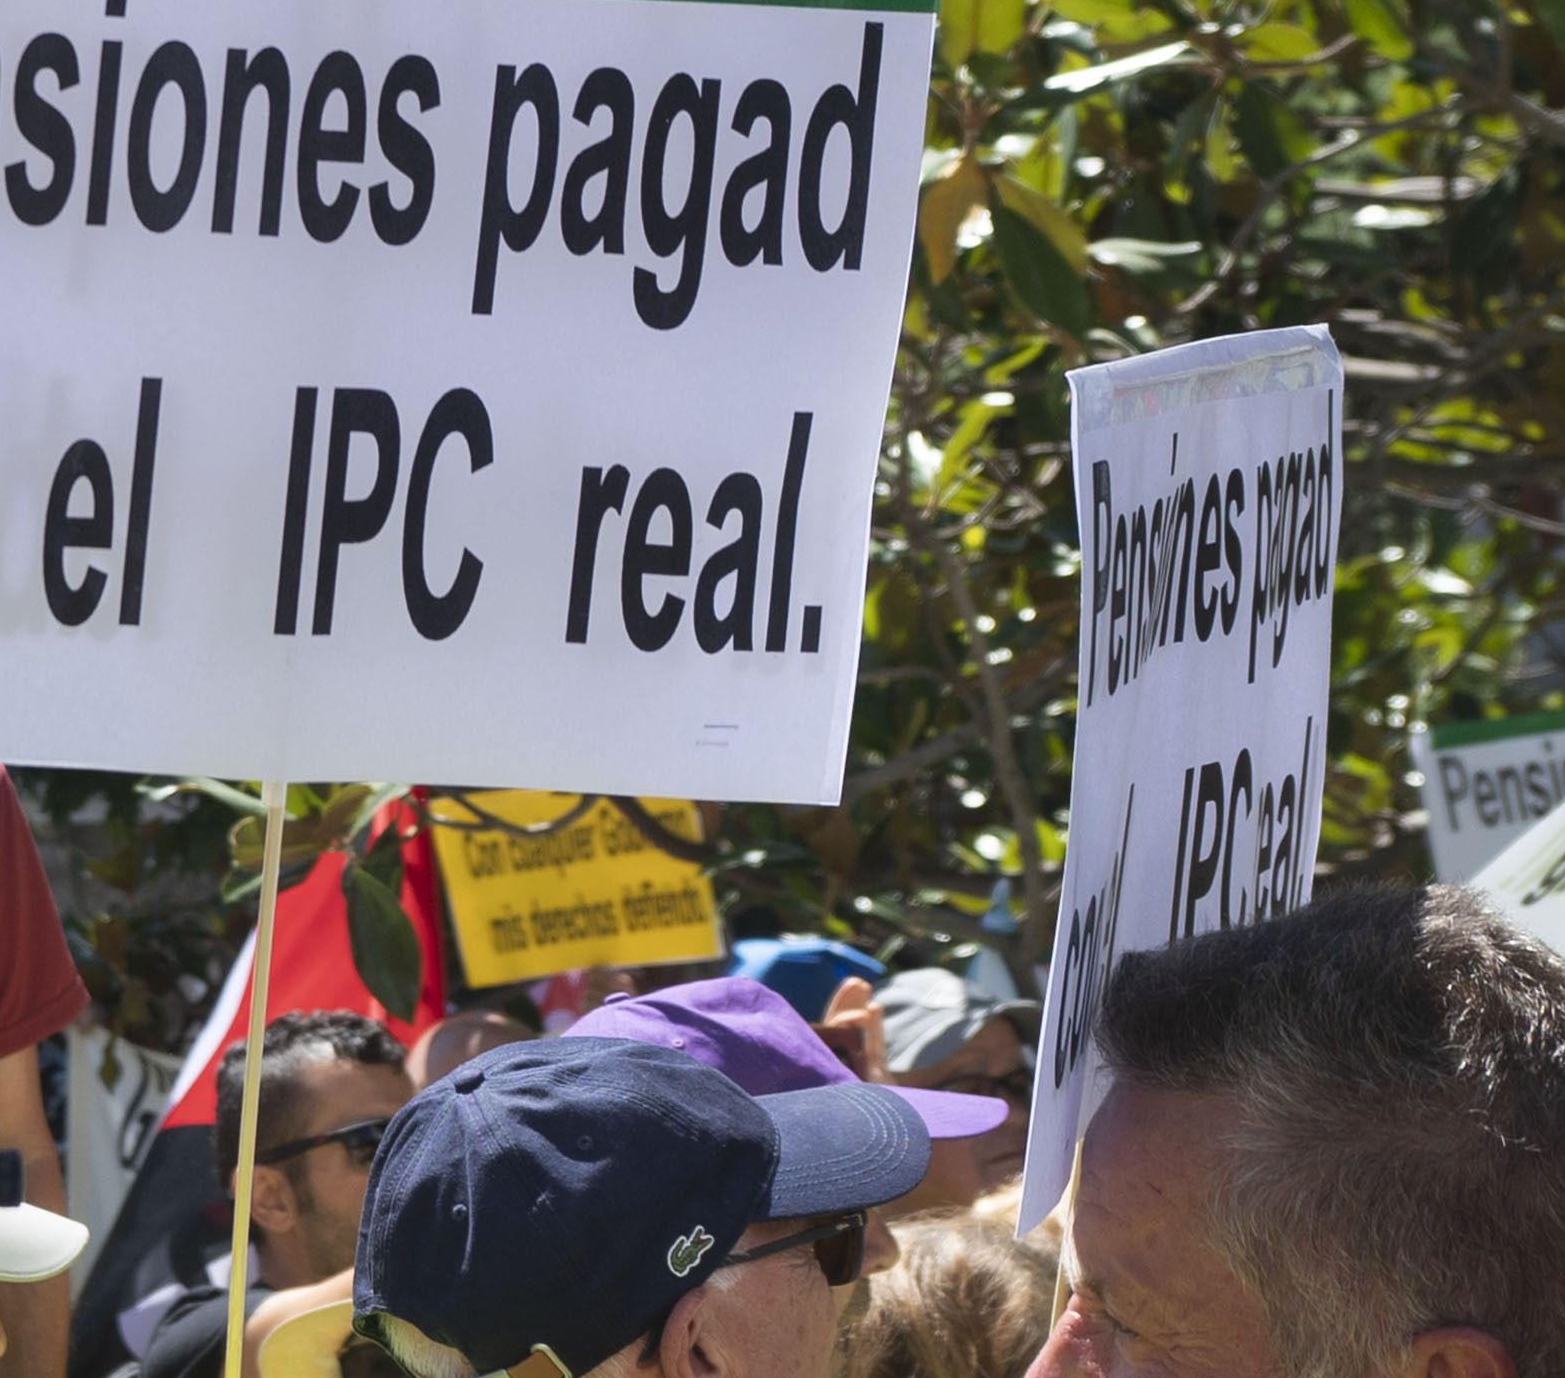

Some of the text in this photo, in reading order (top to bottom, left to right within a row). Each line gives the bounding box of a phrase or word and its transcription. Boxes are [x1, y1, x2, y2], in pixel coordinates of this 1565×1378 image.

[470, 22, 884, 331] pagad
[42, 378, 162, 627] el
[273, 386, 495, 642] IPC
[564, 412, 822, 654] real.
[1171, 747, 1252, 940] IPC
